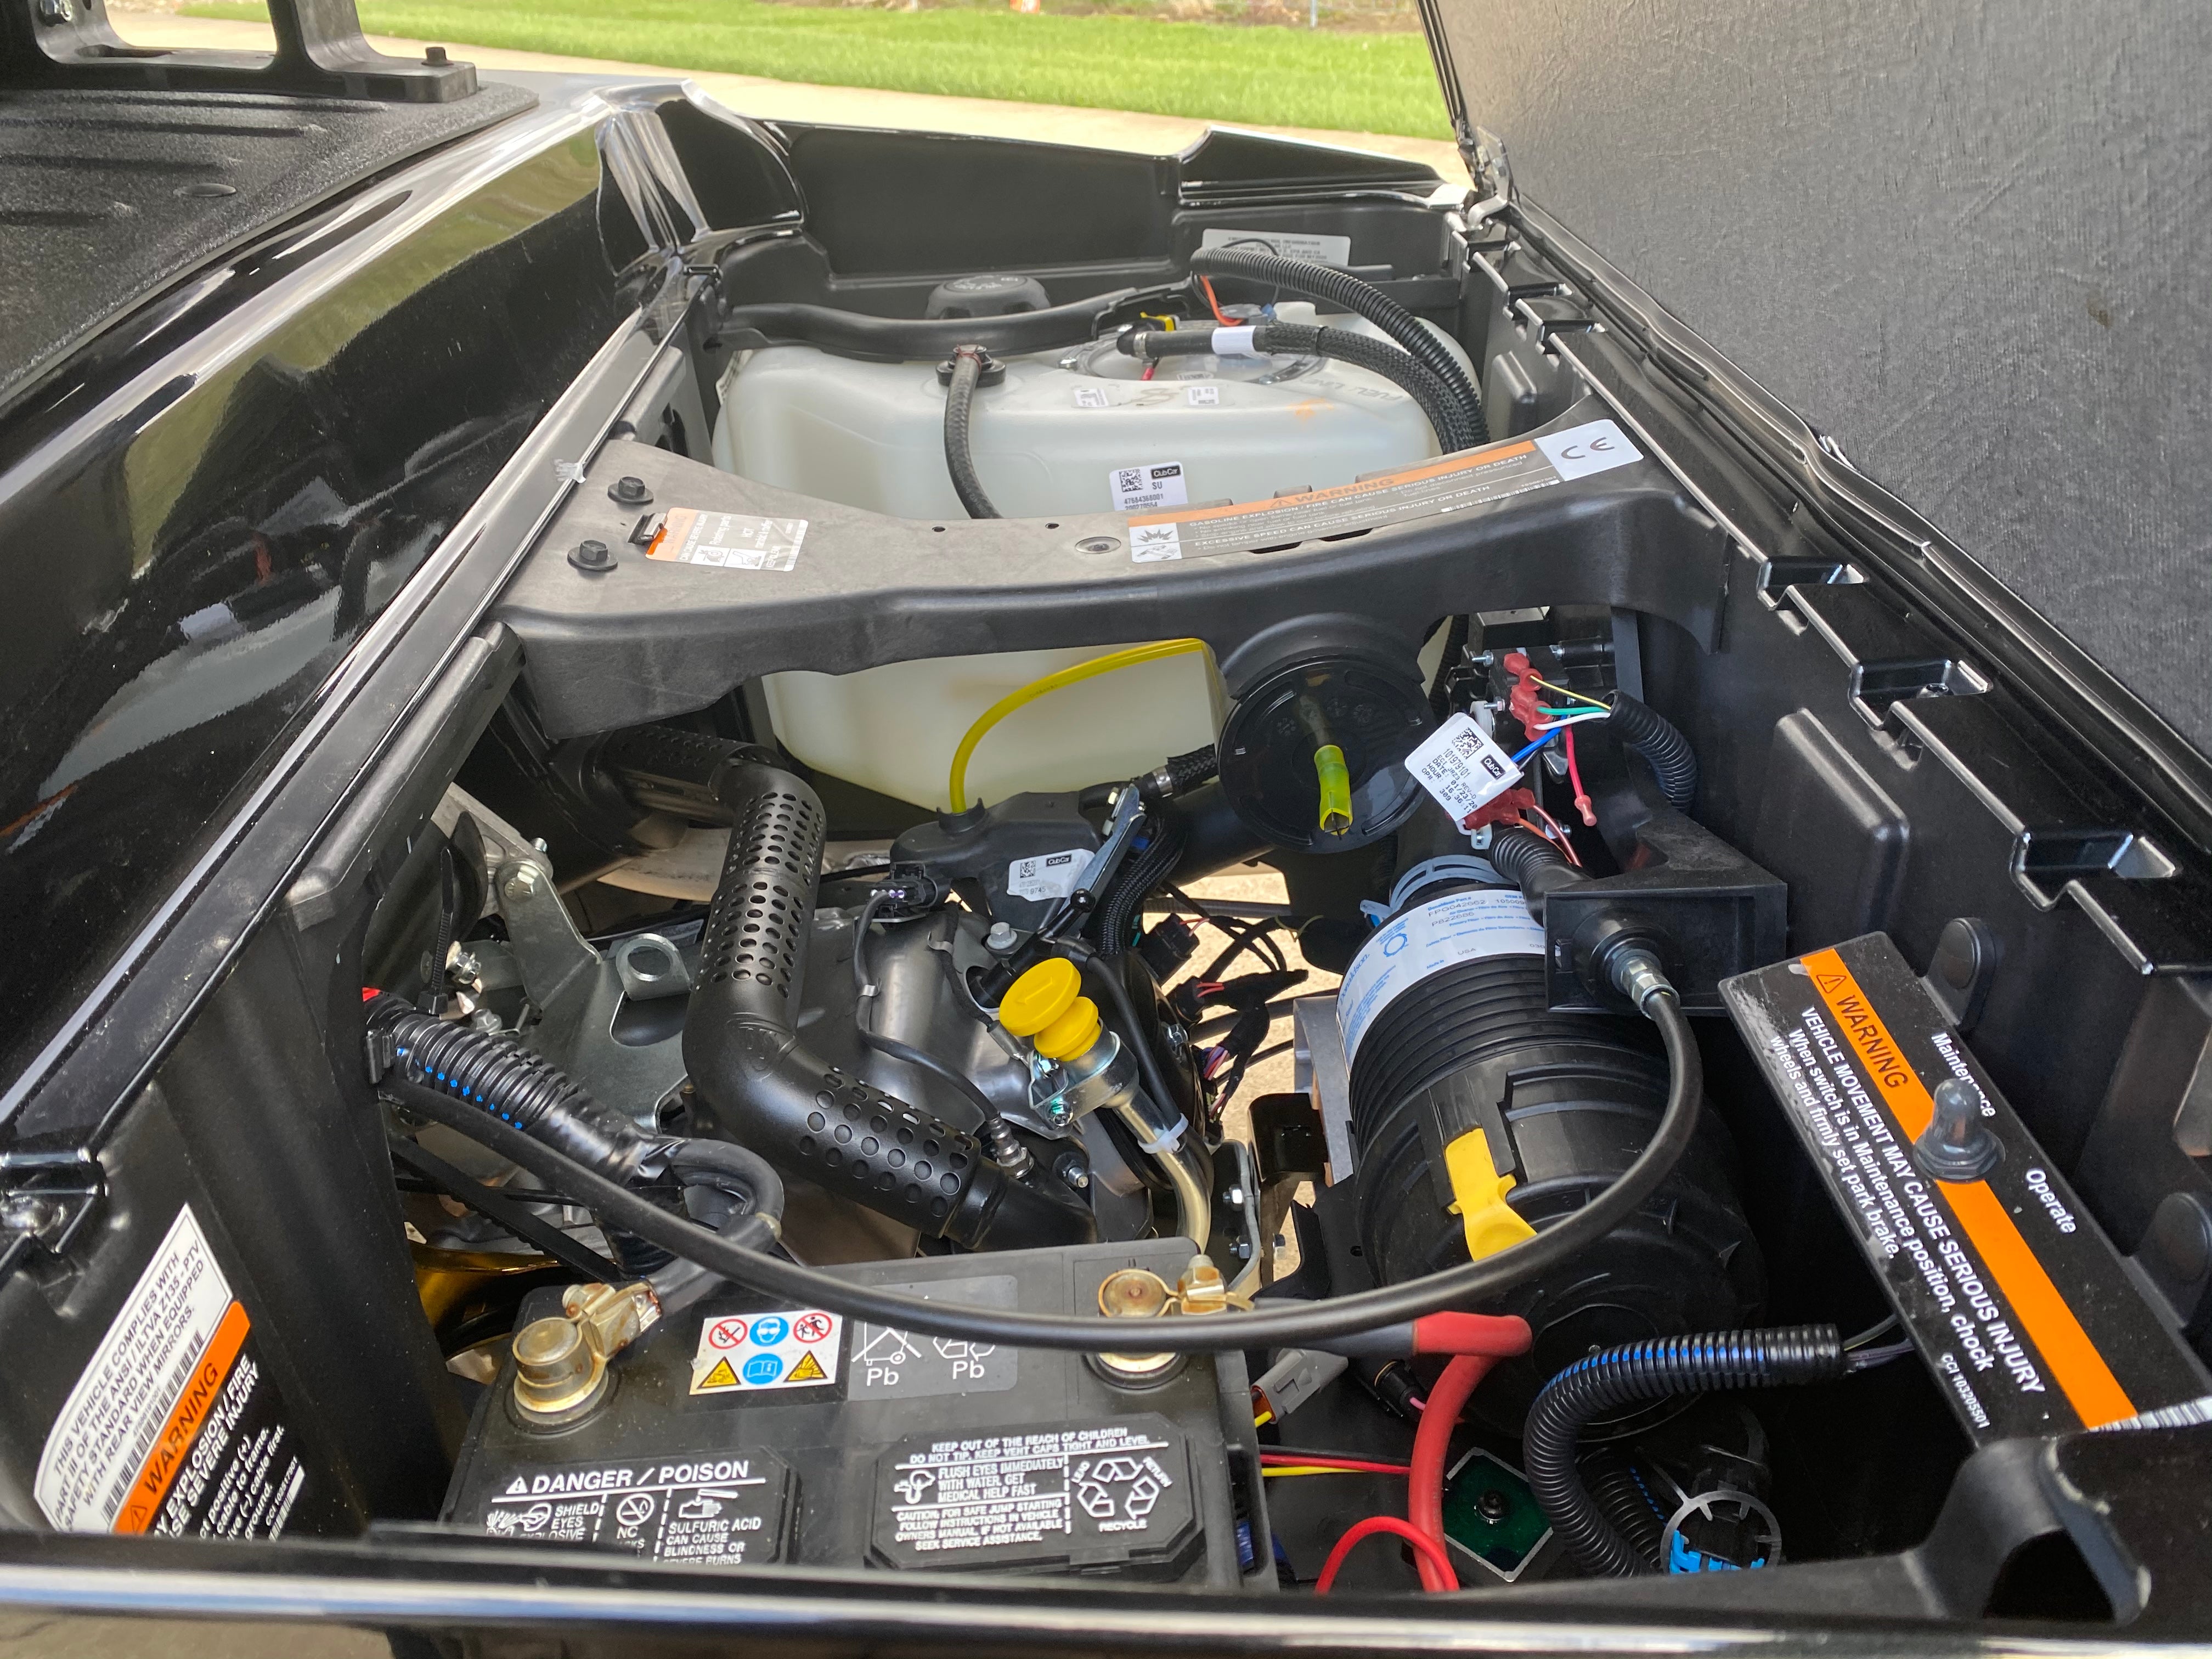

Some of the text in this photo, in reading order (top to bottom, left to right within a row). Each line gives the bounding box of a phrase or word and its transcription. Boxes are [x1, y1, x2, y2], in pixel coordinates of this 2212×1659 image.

[1152, 481, 1163, 489] SU
[1189, 516, 1240, 527] GASOLINE
[1242, 506, 1298, 520] EXPLOSION
[1306, 500, 1329, 509] FIRE
[1331, 495, 1352, 504] CAN
[1354, 488, 1390, 500] CAUSE
[1391, 478, 1436, 492] SERIOUS
[1437, 469, 1473, 480] INJURY
[1493, 454, 1527, 466] DEATH
[1295, 478, 1394, 502] WARNING
[1195, 534, 1251, 546] EXCESSIVE
[1254, 529, 1286, 538] SPEED
[1313, 517, 1349, 528] CAUSE
[1351, 508, 1396, 520] SERIOUS
[1398, 499, 1435, 511] INJURY
[1455, 486, 1490, 497] DEATH
[1443, 748, 1471, 779] 101979101
[1440, 788, 1452, 801] 309
[1451, 780, 1478, 809] 01/23/20
[1461, 782, 1476, 799] REV-D
[1431, 911, 1475, 927] P822686
[1457, 947, 1477, 956] USA
[1836, 995, 1908, 1088] WARNING
[1770, 1035, 1899, 1260] wheels and firmly set park brake.
[1788, 1028, 1995, 1372] When switch is in Maintenance position, chock
[1802, 1007, 2046, 1392] VEHICLE MOVEMENT MAY CAUSE SERIOUS INJURY
[2025, 1167, 2077, 1234] Operate
[54, 1435, 72, 1475] THIS
[71, 1364, 113, 1435] VEHICLE
[112, 1290, 157, 1366] COMPLIES
[156, 1252, 179, 1291] WITH
[867, 1367, 899, 1386] Pb
[952, 1359, 985, 1380] Pb
[55, 1239, 199, 1523] PART III OF THE ANSI ILTVA Z135 PTV
[65, 1461, 89, 1528] SAFETY
[88, 1376, 137, 1464] STANDARD
[136, 1328, 164, 1376] WHEN
[163, 1259, 204, 1331] EQUIPPED
[1940, 1352, 1991, 1429] CCI 103205501
[83, 1460, 106, 1506] WITH
[105, 1414, 133, 1463] REAR
[130, 1372, 155, 1414] VIEW
[153, 1306, 195, 1375] MIRRORS.
[144, 1362, 218, 1496] WARNING
[166, 1403, 227, 1519] EXPLOSION
[227, 1352, 252, 1401] FIRE
[187, 1359, 259, 1507] SEVERE INJURY
[932, 1427, 1127, 1453] KEEP OUT OF THE REACH OF CHILDREN
[250, 1423, 285, 1496] cable first.
[910, 1454, 926, 1464] DO
[928, 1452, 950, 1464] NOT
[975, 1449, 1000, 1459] KEEP
[1003, 1446, 1030, 1457] VENT
[1032, 1444, 1059, 1454] CAPS
[1062, 1441, 1091, 1452] TIGHT
[1094, 1438, 1117, 1448] AND
[216, 1489, 239, 1534] cable
[236, 1470, 247, 1491] to
[244, 1426, 269, 1474] frame.
[532, 1460, 749, 1494] DANGER / POISON
[938, 1457, 1063, 1480] FLUSH EYES IMMEDIATELY
[938, 1472, 1025, 1491] WITH GET
[1071, 1460, 1091, 1484] LEAD
[1142, 1455, 1173, 1488] RETURN
[208, 1457, 241, 1525] positive
[938, 1482, 1037, 1503] MEDICAL HELP FAST
[245, 1480, 274, 1542] ground.
[266, 1503, 276, 1527] CCI
[555, 1502, 599, 1517] SHIELD
[900, 1509, 1059, 1532] FOLLOW INSTRUCTIONS IN VEHICLE
[942, 1499, 1062, 1519] FOR SAFE JUMP STARTING
[551, 1516, 584, 1530] EYES
[668, 1516, 762, 1534] SULFURIC ACID
[895, 1519, 1063, 1542] OWNERS IF NOT AVAILABLE
[1099, 1519, 1147, 1532] RECYCLE
[664, 1542, 745, 1558] BLINDNESS OR
[666, 1532, 729, 1546] CAN CAUSE
[915, 1540, 940, 1551] SEEK
[943, 1536, 981, 1549] SERVICE
